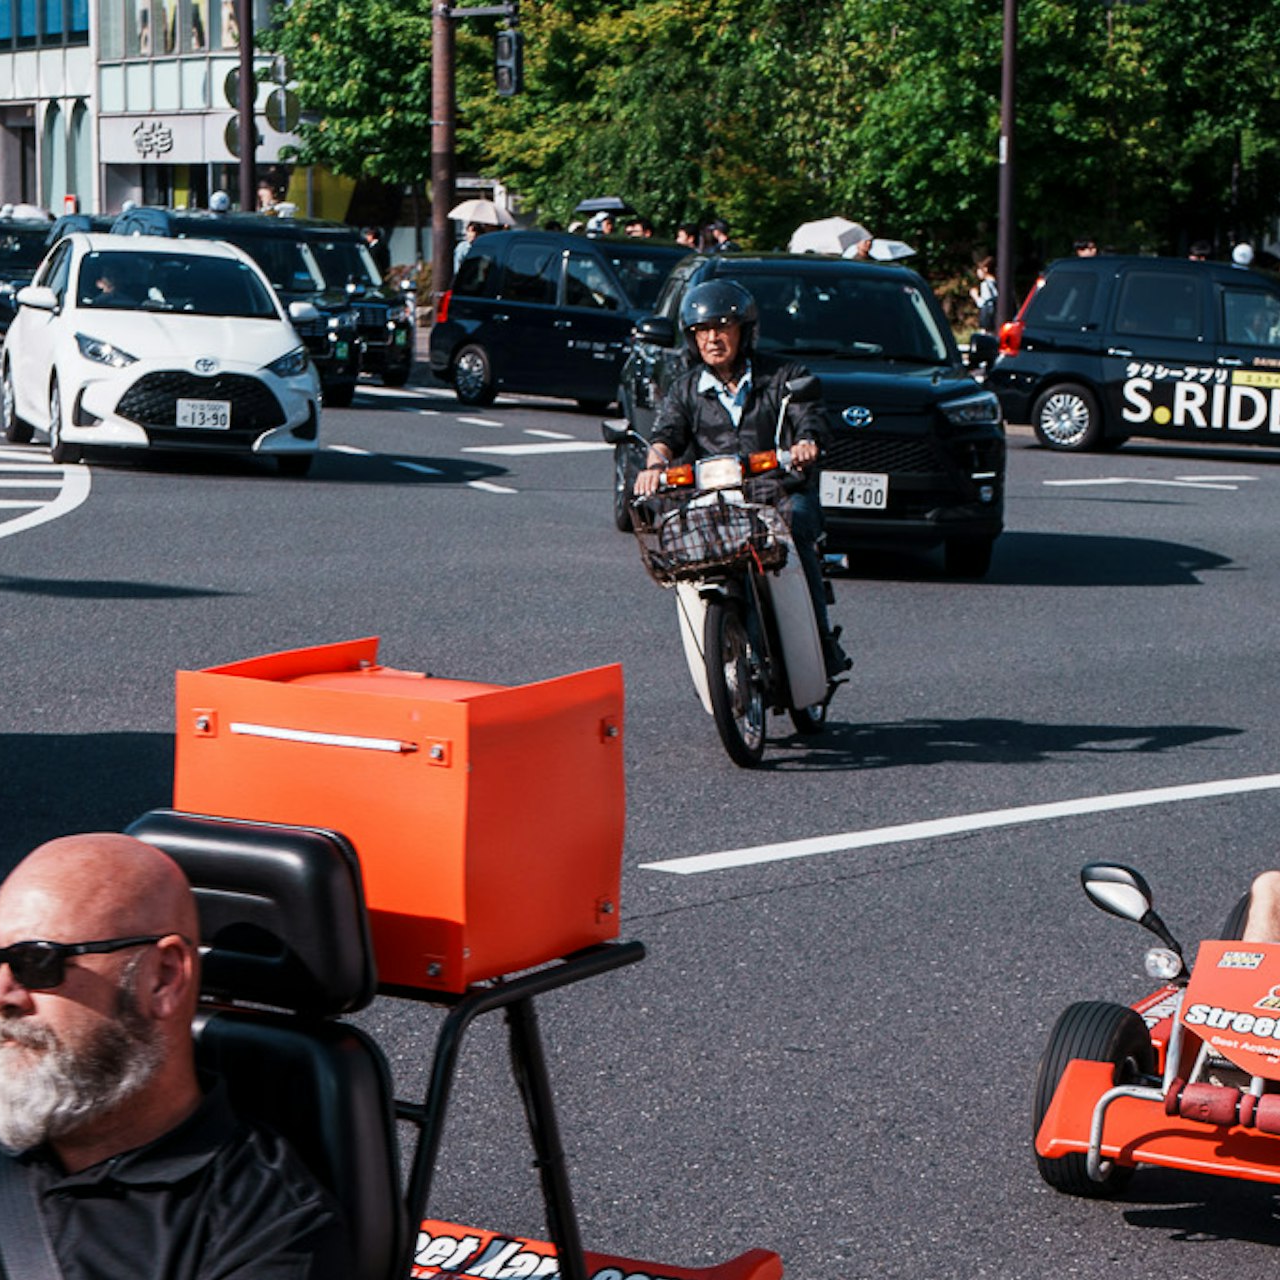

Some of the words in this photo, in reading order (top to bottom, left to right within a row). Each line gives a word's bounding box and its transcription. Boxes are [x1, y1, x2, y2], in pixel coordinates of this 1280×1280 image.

[1126, 362, 1228, 383] タクシーアプリ
